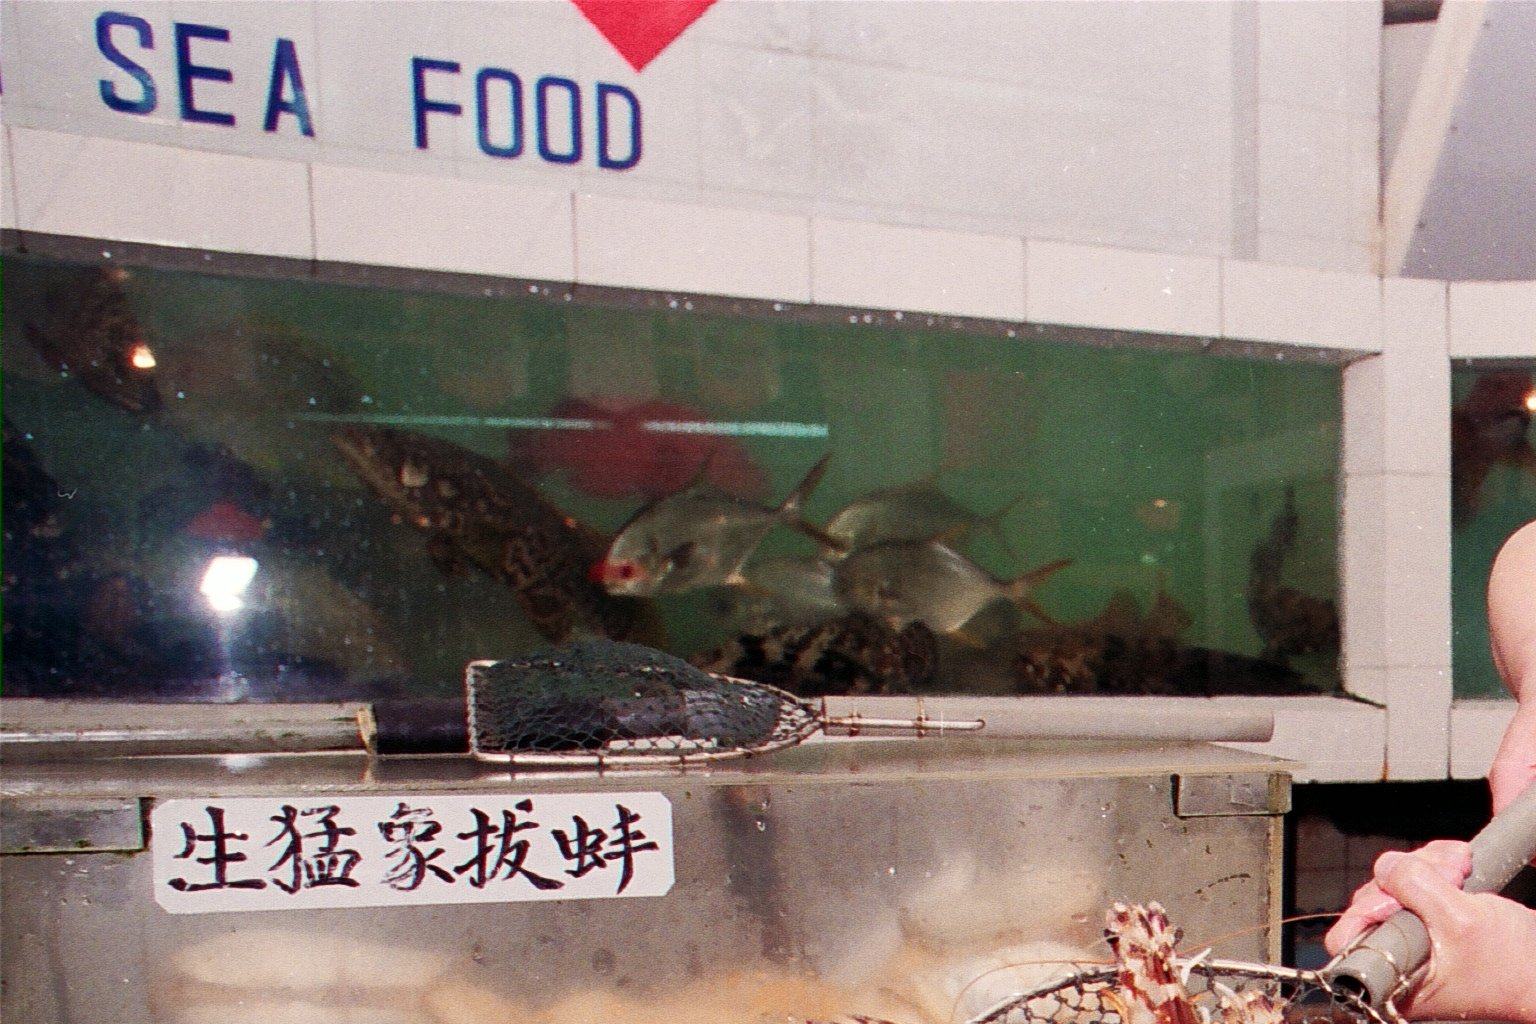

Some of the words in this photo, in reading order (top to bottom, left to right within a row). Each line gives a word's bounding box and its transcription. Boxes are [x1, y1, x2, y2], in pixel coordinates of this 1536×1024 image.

[94, 10, 315, 138] SEA
[410, 56, 643, 171] FOOD
[169, 799, 659, 894] 生猛象拔蚌
